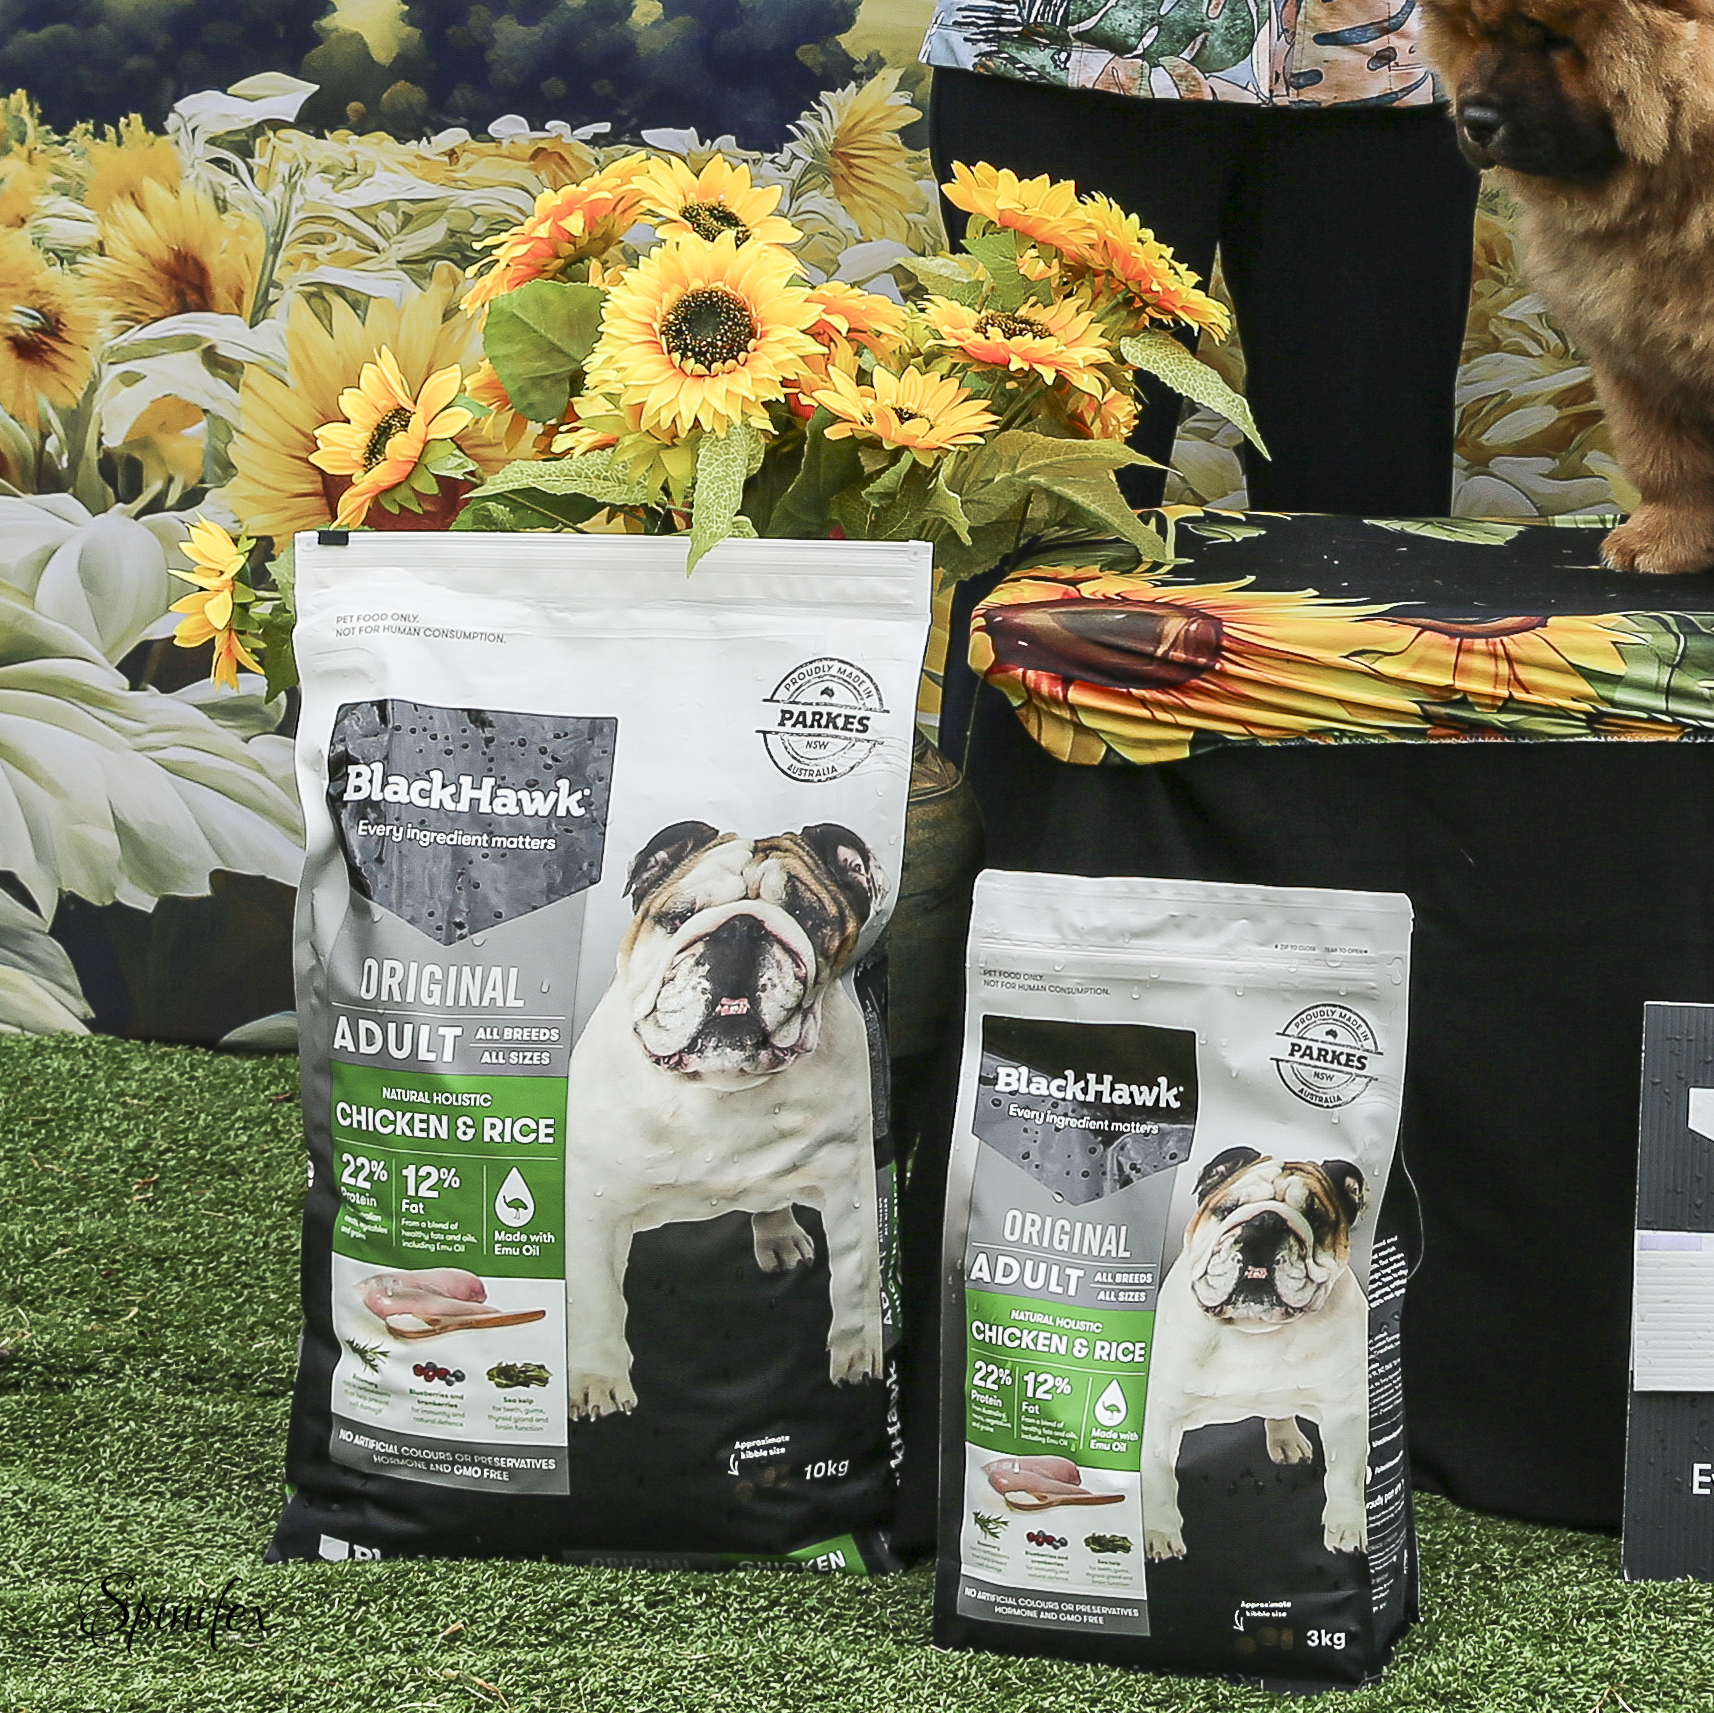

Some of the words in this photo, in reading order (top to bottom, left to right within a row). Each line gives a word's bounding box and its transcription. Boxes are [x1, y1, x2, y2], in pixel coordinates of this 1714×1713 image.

[336, 615, 354, 624] PET
[357, 613, 388, 623] FOOD
[391, 613, 419, 623] ONLY.
[335, 627, 356, 637] NOT
[359, 625, 380, 634] FOR
[383, 625, 420, 636] HUMAN
[424, 628, 507, 644] CONSUMPTION.
[784, 664, 834, 691] PROUDLY
[836, 667, 866, 690] MADE
[863, 687, 874, 699] IN
[777, 709, 871, 733] PARKES
[806, 741, 829, 749] NSW
[786, 764, 837, 777] AUSTRALIA
[357, 819, 404, 842] Every
[406, 824, 489, 847] ingredient
[491, 837, 556, 850] matters
[360, 957, 525, 1008] ORIGINAL
[475, 1027, 500, 1040] ALL
[503, 1028, 560, 1041] BREEDS
[1294, 1010, 1336, 1029] PROUDLY
[1339, 1012, 1363, 1030] MADE
[1360, 1030, 1369, 1041] IN
[333, 1016, 462, 1062] ADULT
[481, 1051, 506, 1064] ALL
[509, 1051, 550, 1065] SIZES
[1288, 1043, 1368, 1070] PARKES
[1313, 1072, 1334, 1081] NSW
[382, 1087, 430, 1103] NATURAL
[433, 1092, 492, 1107] HOLISTIC
[1298, 1088, 1342, 1103] AUSTRALIA
[336, 1102, 448, 1139] CHICKEN
[456, 1116, 475, 1141] &
[483, 1118, 554, 1144] RICE
[1009, 1104, 1045, 1125] Every
[1046, 1110, 1109, 1131] ingredient
[1111, 1122, 1159, 1135] matters
[341, 1154, 387, 1190] 22%
[401, 1164, 460, 1198] 12%
[401, 1199, 425, 1214] Fat
[494, 1231, 527, 1243] Made
[530, 1232, 555, 1243] with
[1003, 1209, 1131, 1258] ORIGINAL
[494, 1244, 520, 1256] Emu
[522, 1245, 539, 1256] Oil
[970, 1253, 1084, 1296] ADULT
[1094, 1272, 1113, 1282] ALL
[1115, 1273, 1152, 1283] BREEDS
[1097, 1291, 1116, 1301] ALL
[1118, 1291, 1146, 1302] SIZES
[1011, 1310, 1053, 1325] NATURAL
[1056, 1317, 1103, 1333] HOLISTIC
[971, 1321, 1068, 1354] CHICKEN
[1073, 1338, 1089, 1358] &
[1094, 1341, 1146, 1363] RICE
[973, 1361, 1012, 1390] 22%
[1023, 1371, 1072, 1400] 12%
[971, 1389, 1002, 1407] Protein
[1022, 1401, 1040, 1414] Fat
[804, 1460, 849, 1480] 10kg
[1306, 1629, 1346, 1650] 3kg
